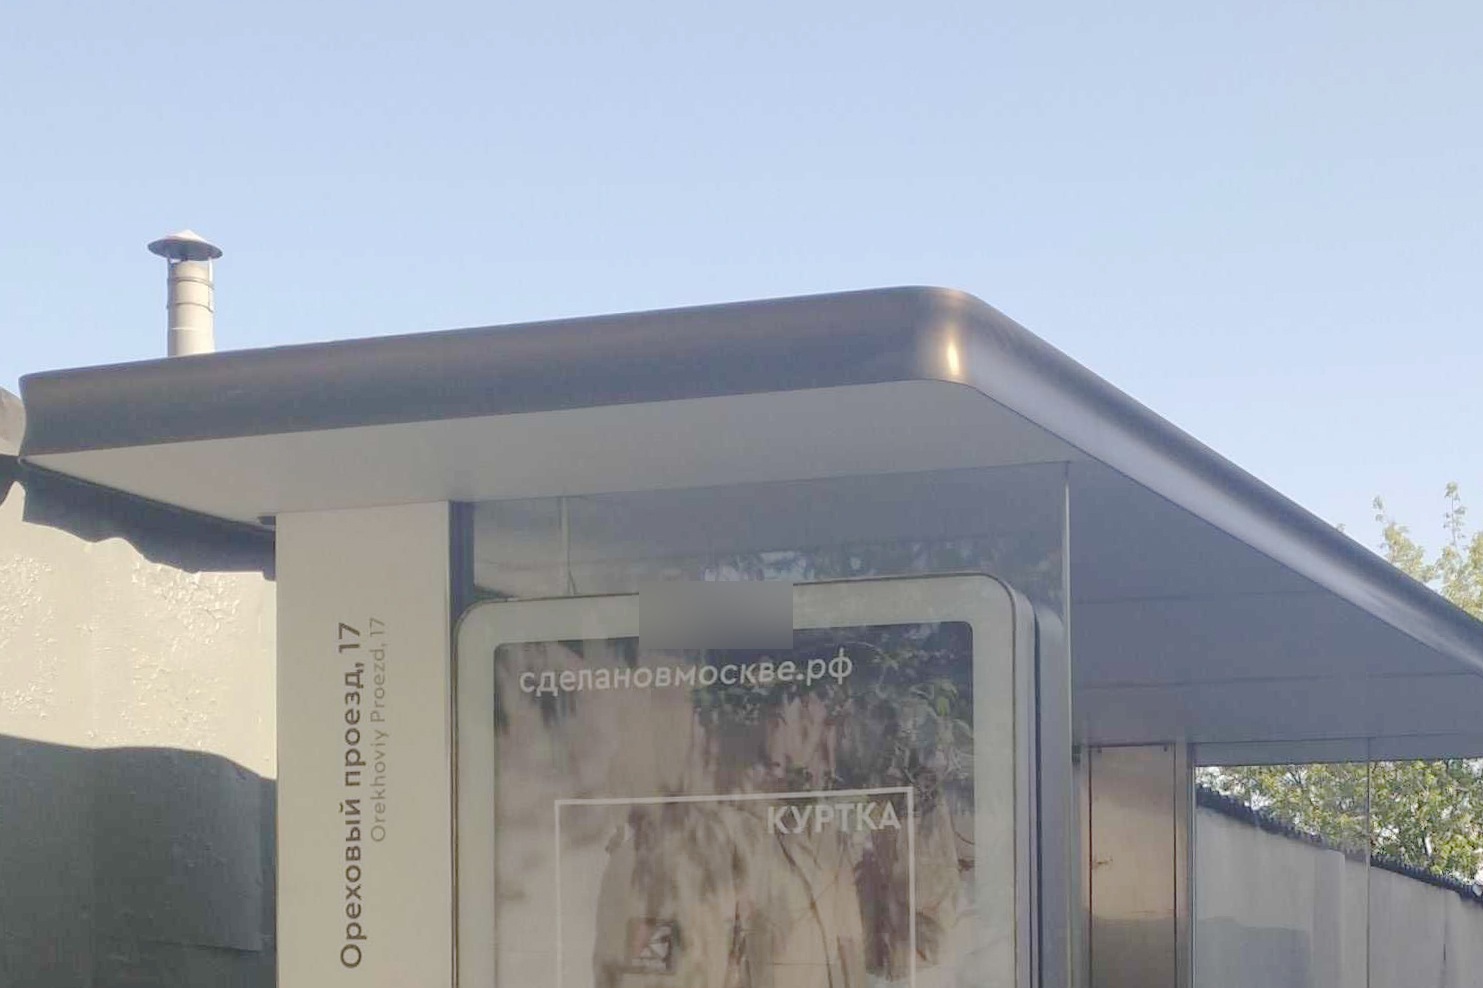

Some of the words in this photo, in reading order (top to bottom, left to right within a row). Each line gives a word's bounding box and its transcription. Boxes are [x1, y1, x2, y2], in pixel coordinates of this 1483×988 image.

[338, 622, 361, 653] 17
[369, 617, 386, 639] 17
[369, 642, 388, 724] Proezd,
[519, 646, 853, 697] сделановмоскве.рф
[345, 662, 366, 787] проезд,
[370, 729, 389, 843] Orekhoviy
[767, 801, 902, 834] КУРТКА
[340, 798, 367, 968] Ореховый
